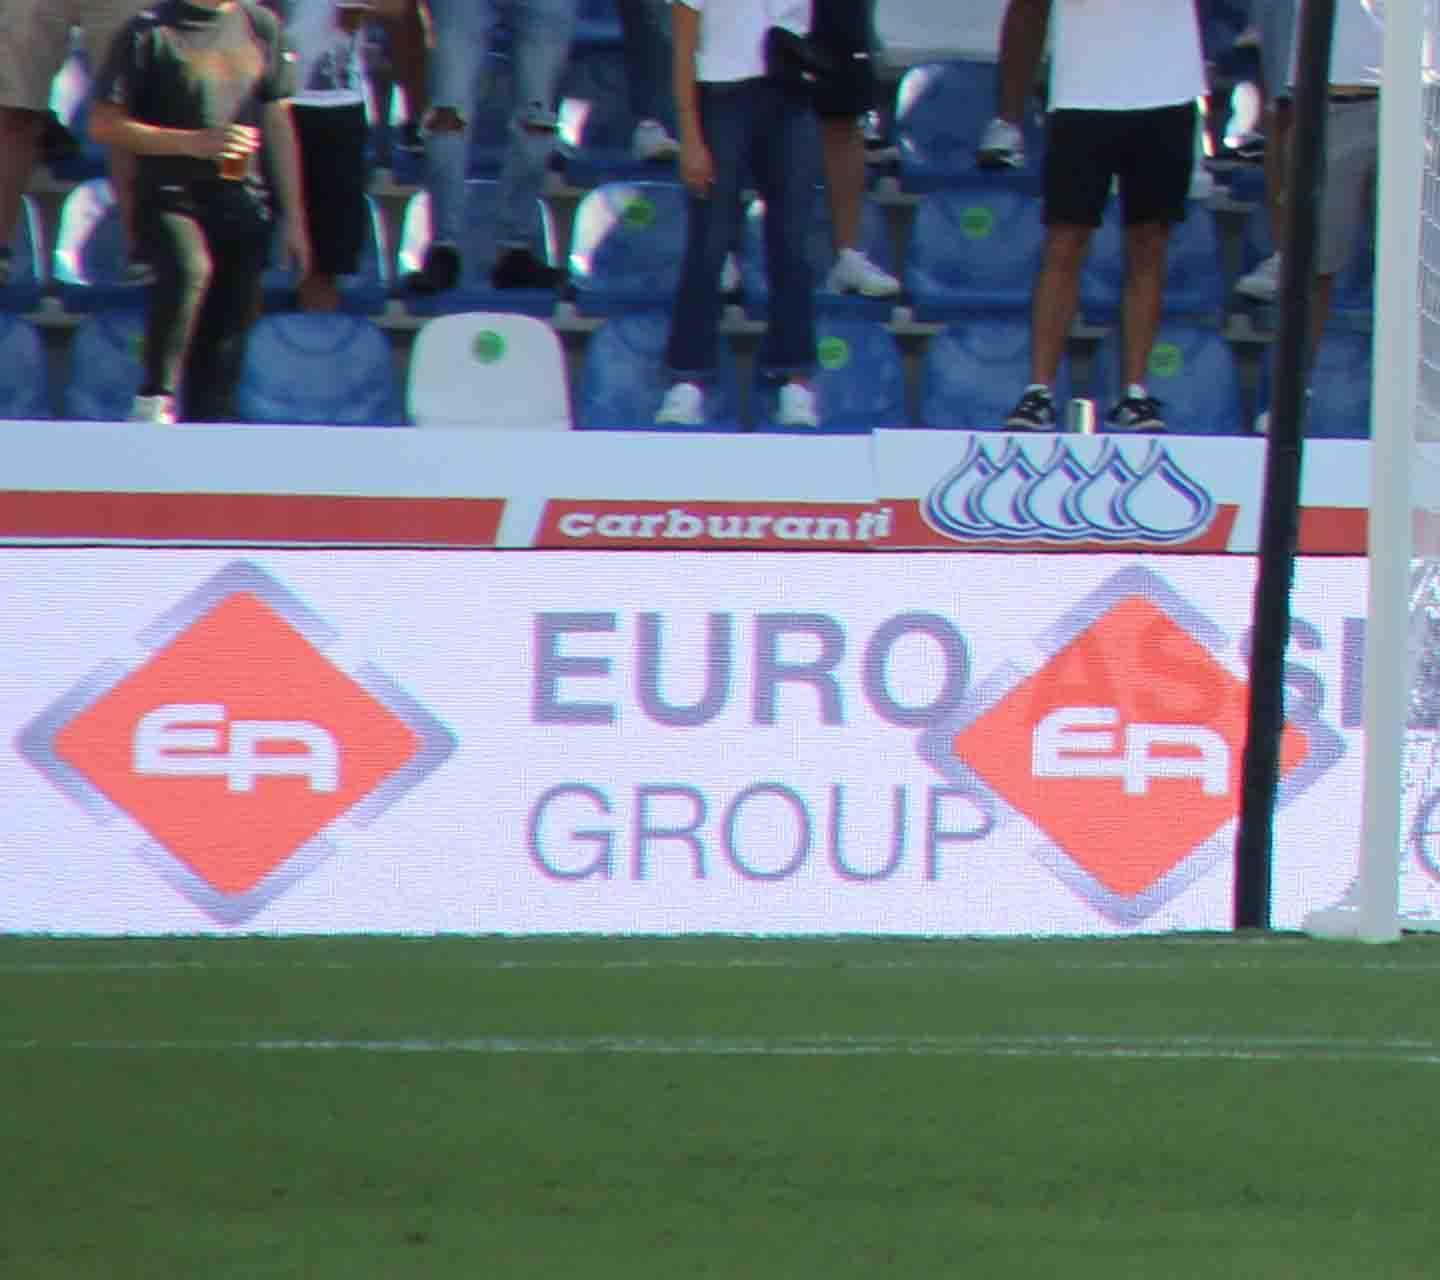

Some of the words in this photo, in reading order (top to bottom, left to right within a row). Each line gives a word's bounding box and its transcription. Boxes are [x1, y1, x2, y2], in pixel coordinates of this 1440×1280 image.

[557, 504, 893, 545] carburanti
[530, 610, 973, 731] EURO
[132, 702, 342, 793] EA
[528, 780, 997, 884] GROUP
